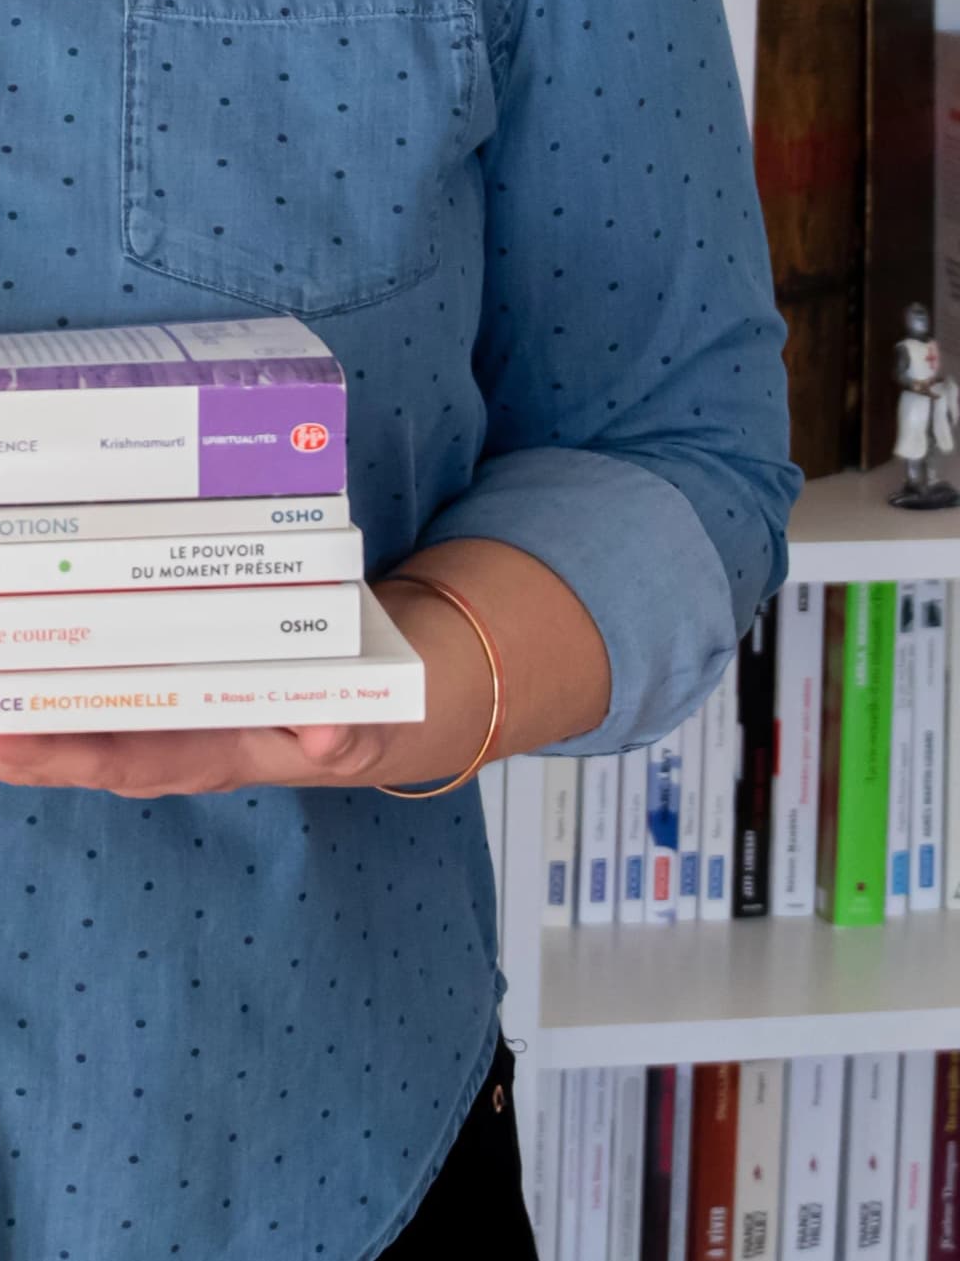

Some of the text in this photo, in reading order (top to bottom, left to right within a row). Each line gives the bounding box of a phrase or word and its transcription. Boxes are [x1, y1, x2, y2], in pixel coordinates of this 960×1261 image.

[99, 436, 186, 450] Krishnamurti
[271, 508, 325, 524] OSHO
[170, 543, 266, 560] LE POUVOIR
[131, 558, 304, 580] DU MOMENT PRÉSENT
[11, 625, 92, 644] courage
[279, 618, 329, 634] OSHO
[29, 691, 179, 711] ÉMOTIONNELLE
[203, 692, 218, 703] R.
[221, 690, 256, 703] Rossi
[267, 690, 281, 702] C.
[339, 687, 353, 700] D.
[357, 684, 391, 701] Noyé
